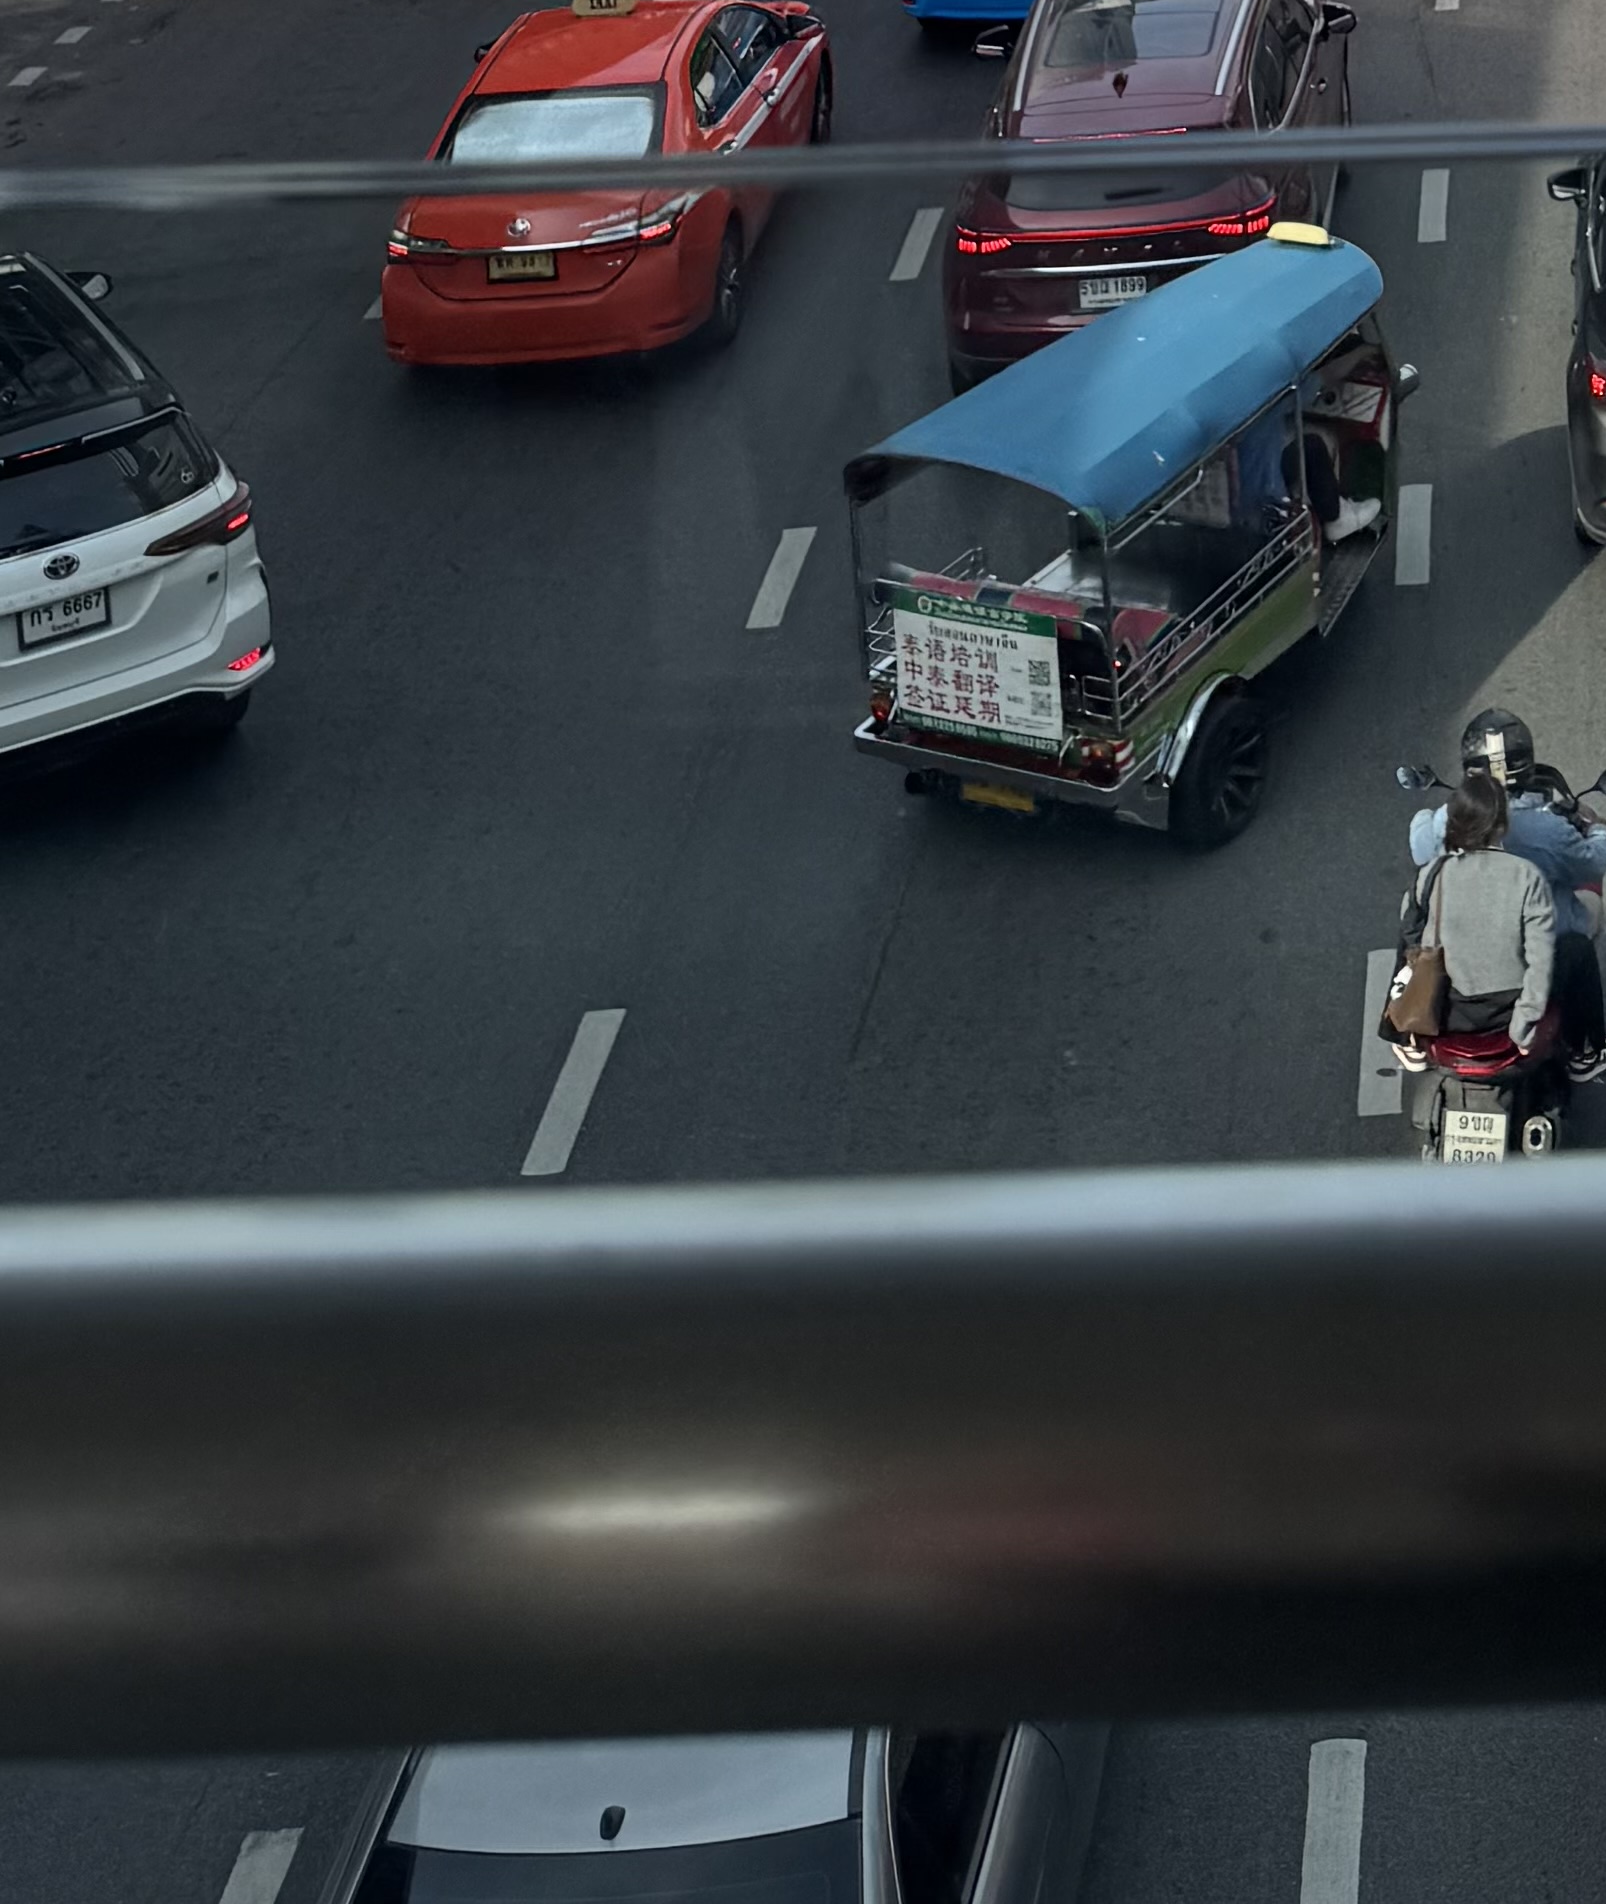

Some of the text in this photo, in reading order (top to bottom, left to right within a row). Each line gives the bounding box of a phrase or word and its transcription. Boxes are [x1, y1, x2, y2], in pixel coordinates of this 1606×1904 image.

[63, 592, 102, 617] 6667
[904, 659, 1000, 698] 中泰翻译
[904, 684, 1001, 724] 签证延期
